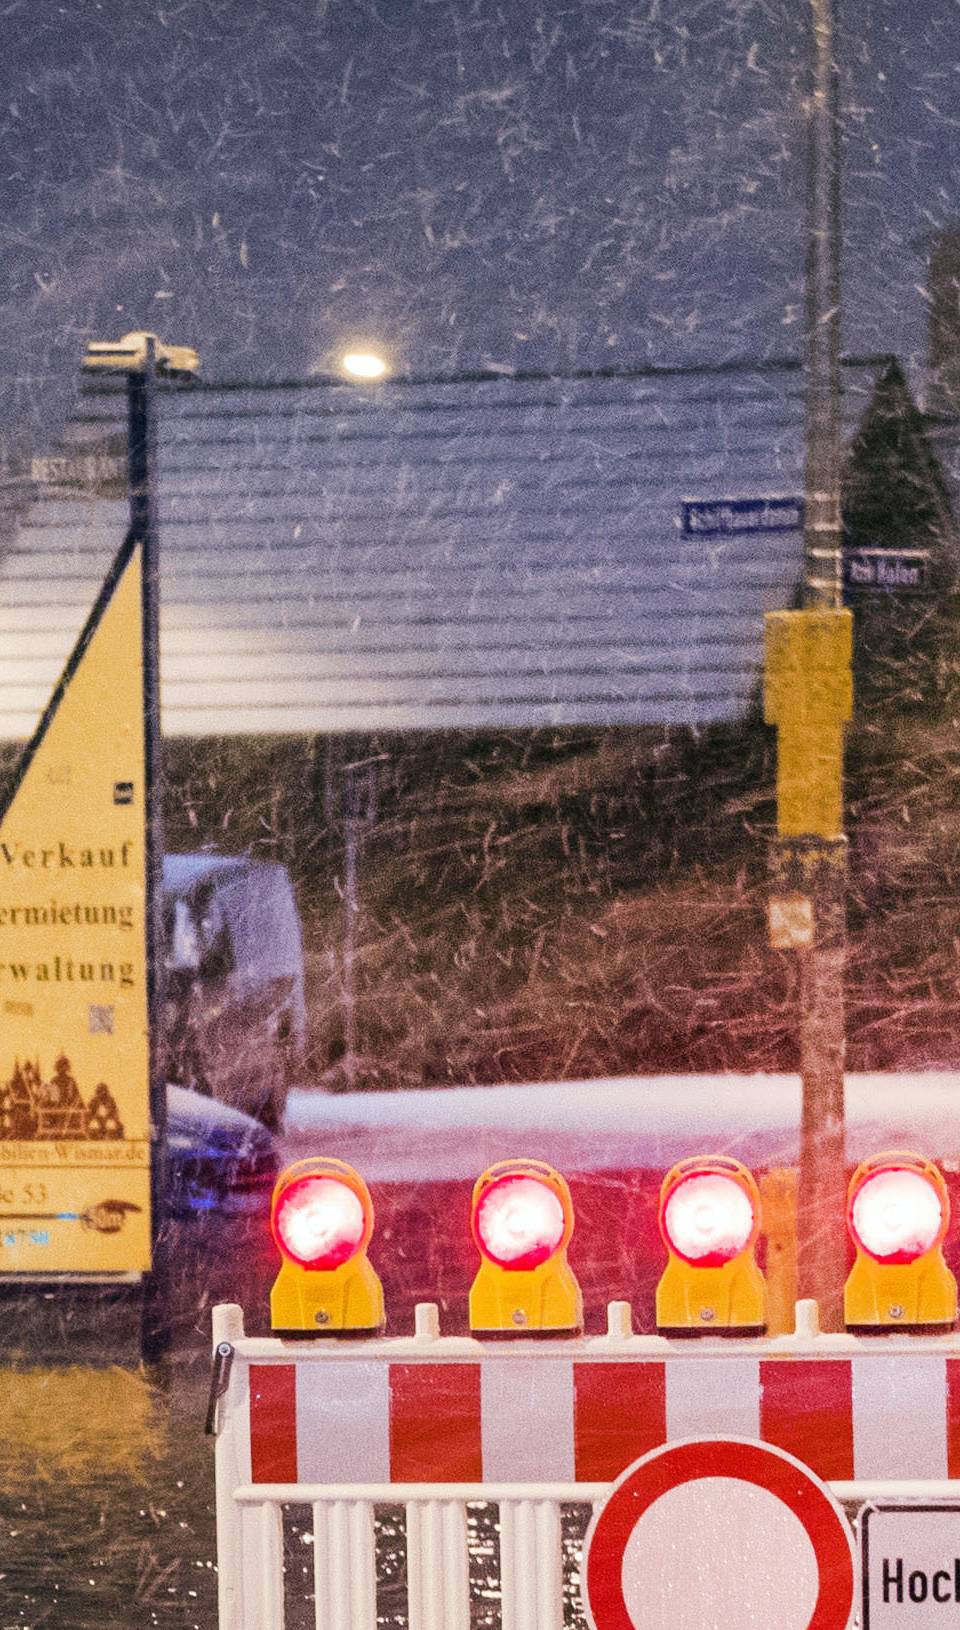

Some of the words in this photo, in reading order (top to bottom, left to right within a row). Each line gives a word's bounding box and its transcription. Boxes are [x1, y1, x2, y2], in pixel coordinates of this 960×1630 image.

[0, 841, 133, 868] Verkauf
[23, 1182, 48, 1204] 53
[882, 1558, 960, 1604] Hoc
